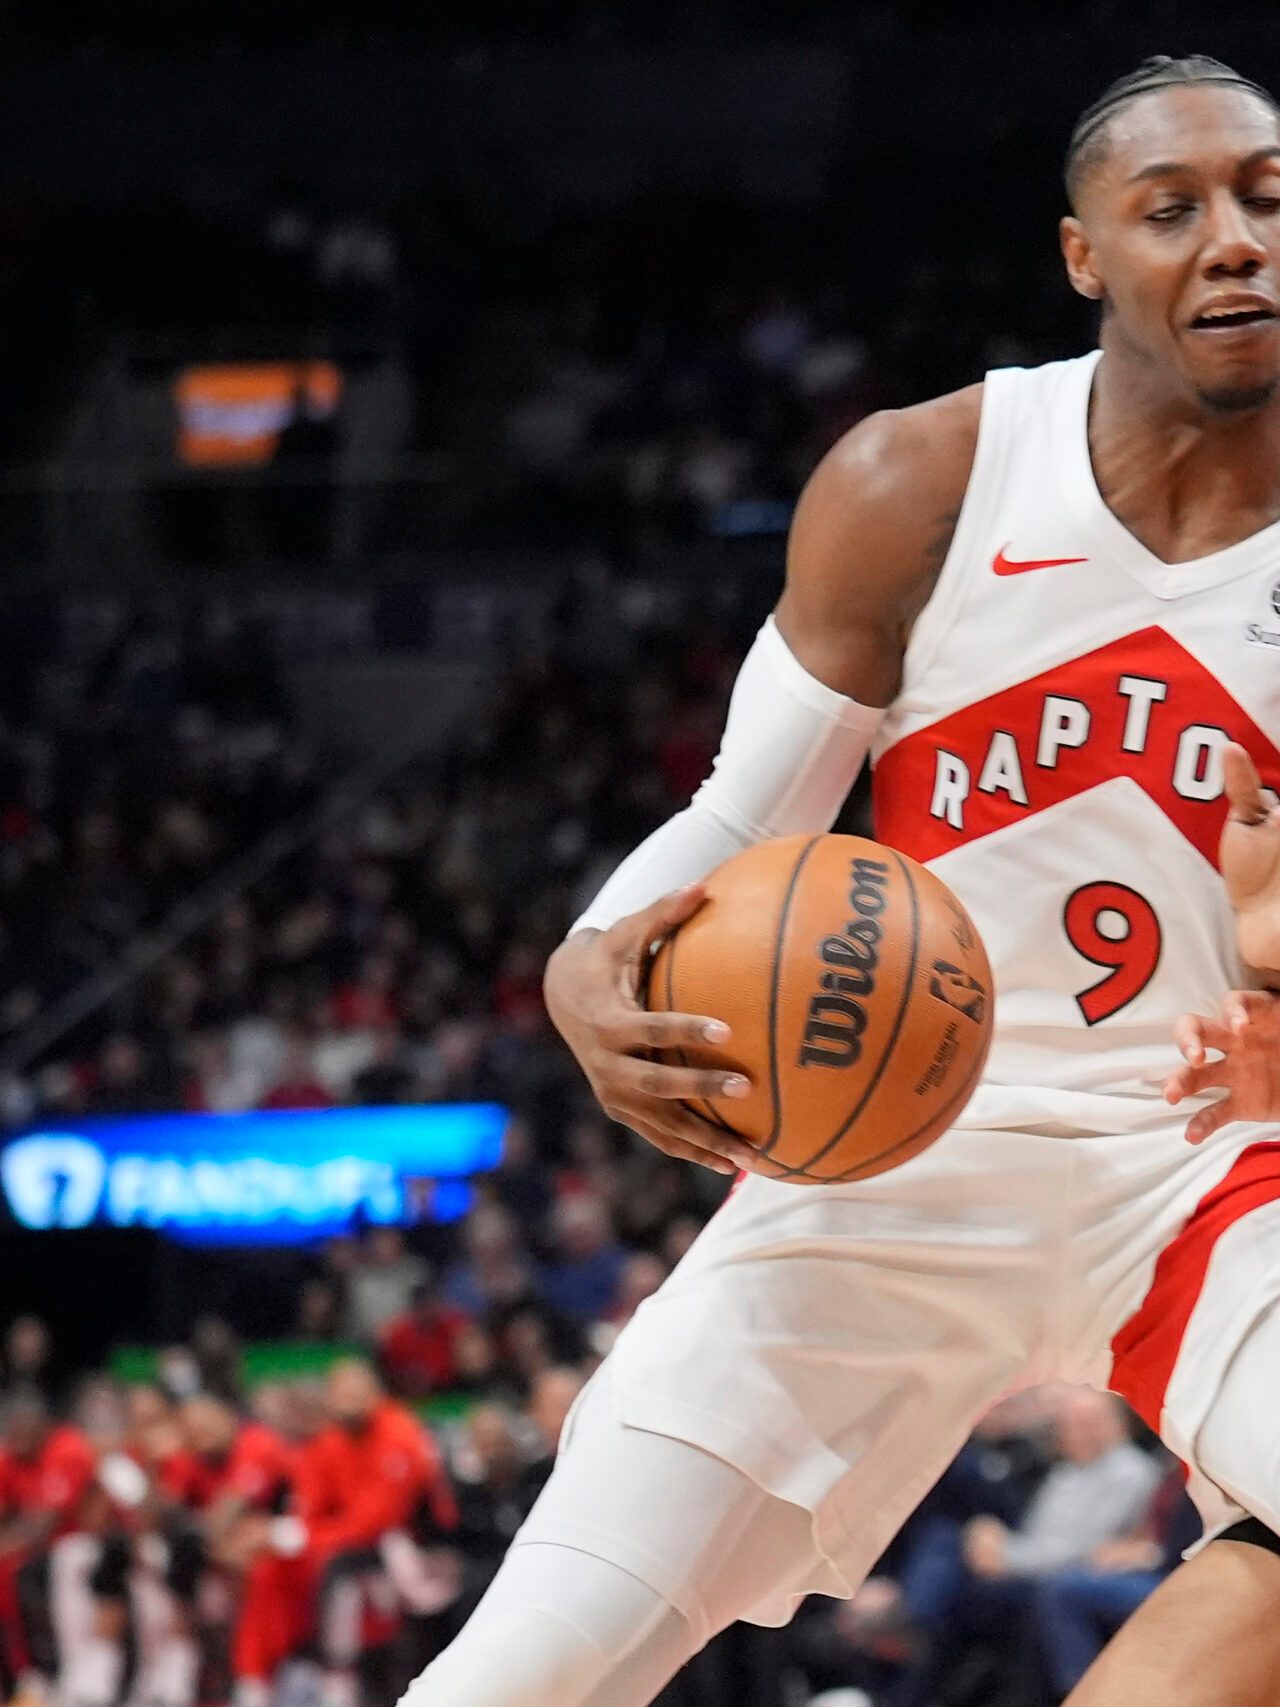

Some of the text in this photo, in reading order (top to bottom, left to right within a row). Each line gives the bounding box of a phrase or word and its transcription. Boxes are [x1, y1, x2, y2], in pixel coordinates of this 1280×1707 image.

[929, 674, 1280, 831] RAPTO
[796, 858, 889, 1069] Wilson
[1062, 880, 1163, 1027] 9
